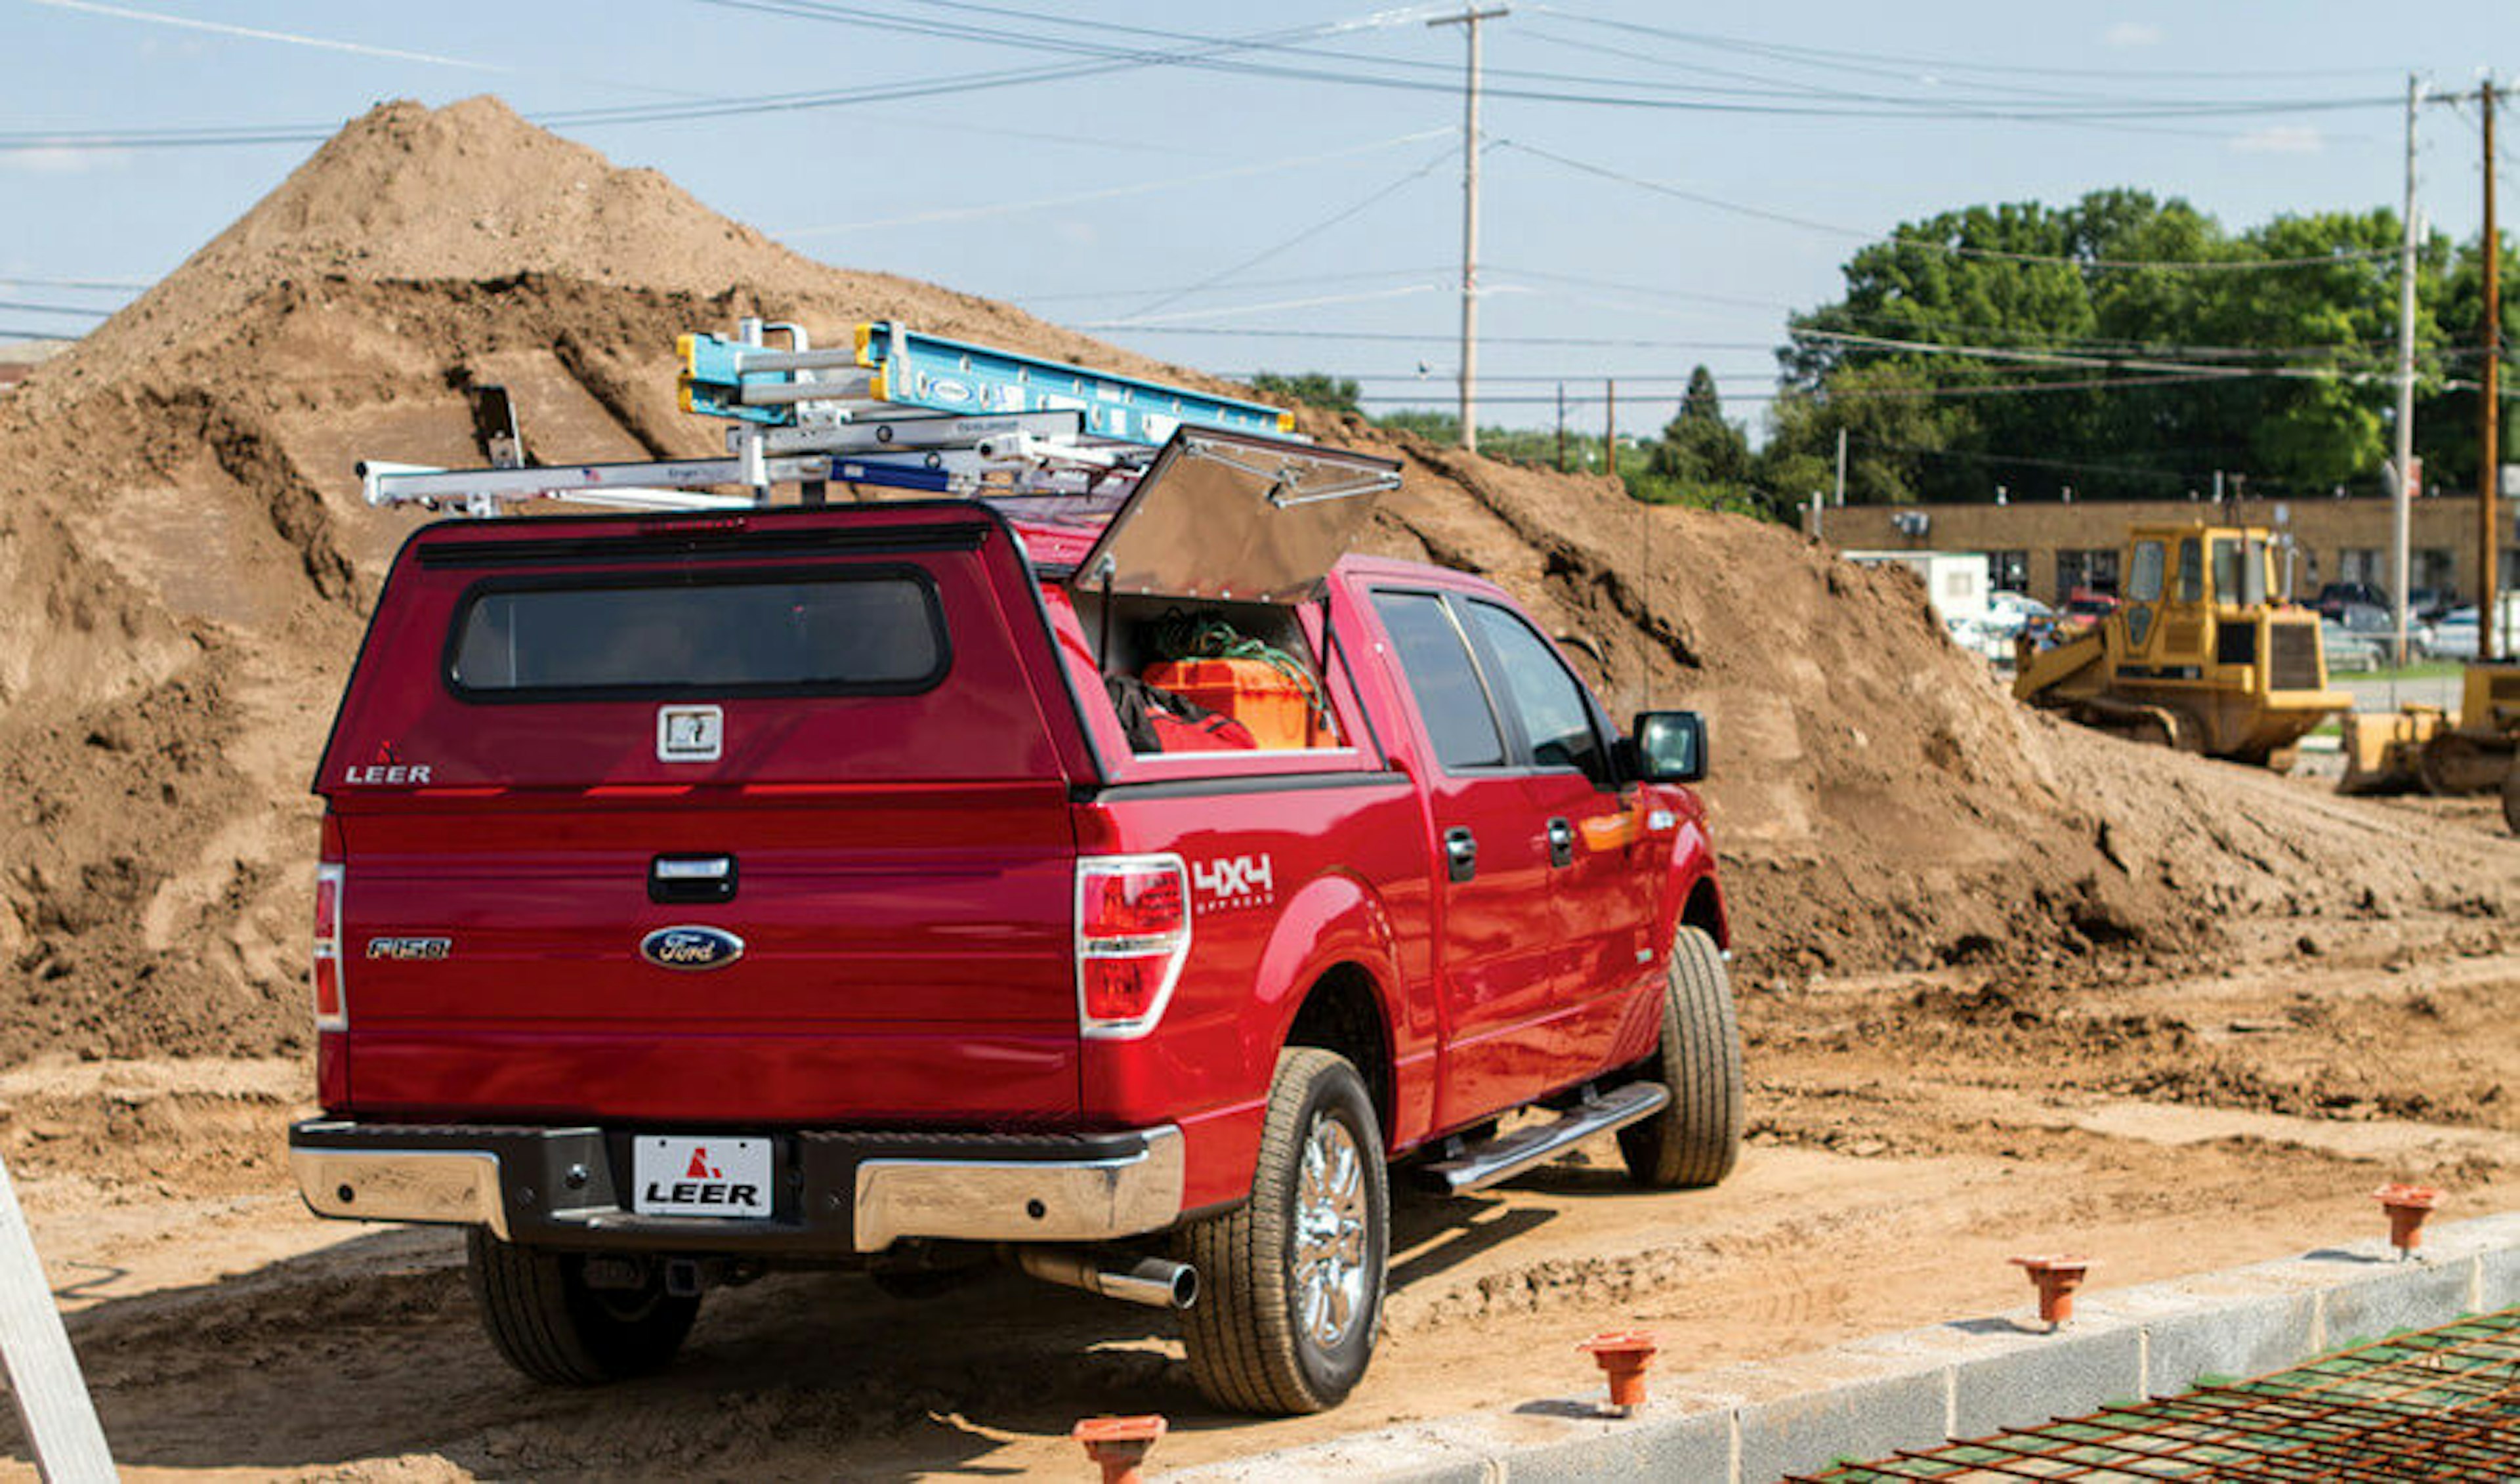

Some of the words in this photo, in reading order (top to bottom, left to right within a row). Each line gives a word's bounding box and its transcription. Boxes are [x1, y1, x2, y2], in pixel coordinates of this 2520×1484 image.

[345, 765, 431, 783] LEER
[659, 934, 715, 961] Ford
[646, 1183, 758, 1206] LEER
